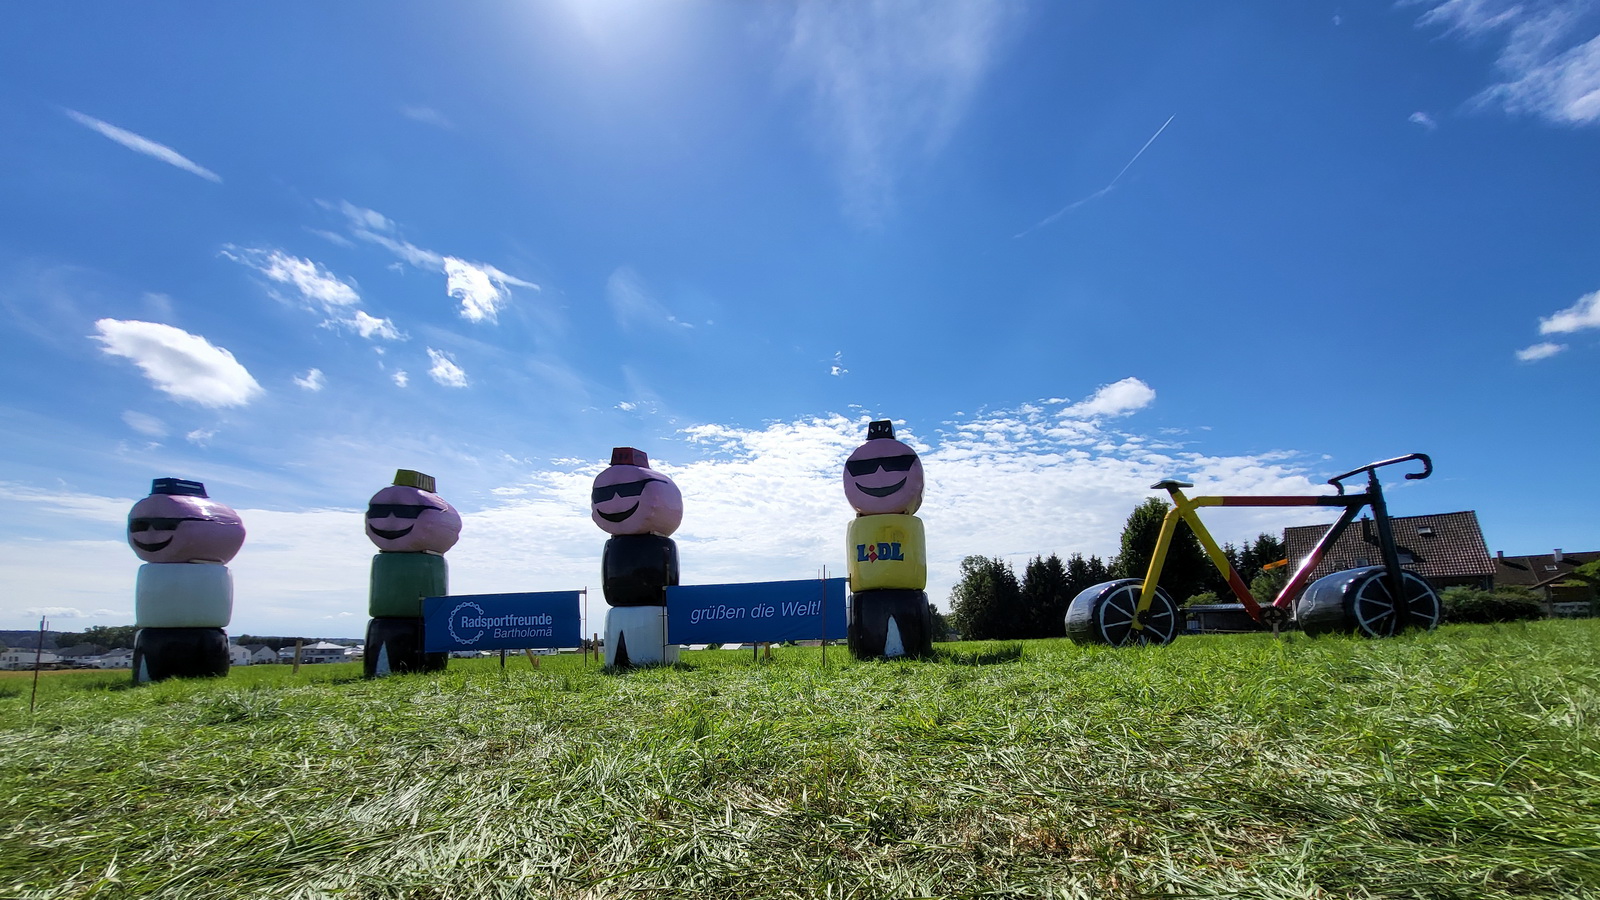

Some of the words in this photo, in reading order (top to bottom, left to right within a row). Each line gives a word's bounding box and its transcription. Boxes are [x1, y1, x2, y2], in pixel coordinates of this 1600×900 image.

[690, 605, 746, 624] grüßen
[751, 603, 775, 618] die
[781, 600, 821, 616] Welt!
[461, 613, 553, 629] Radsportfreunde
[493, 627, 553, 638] Bartholomä
